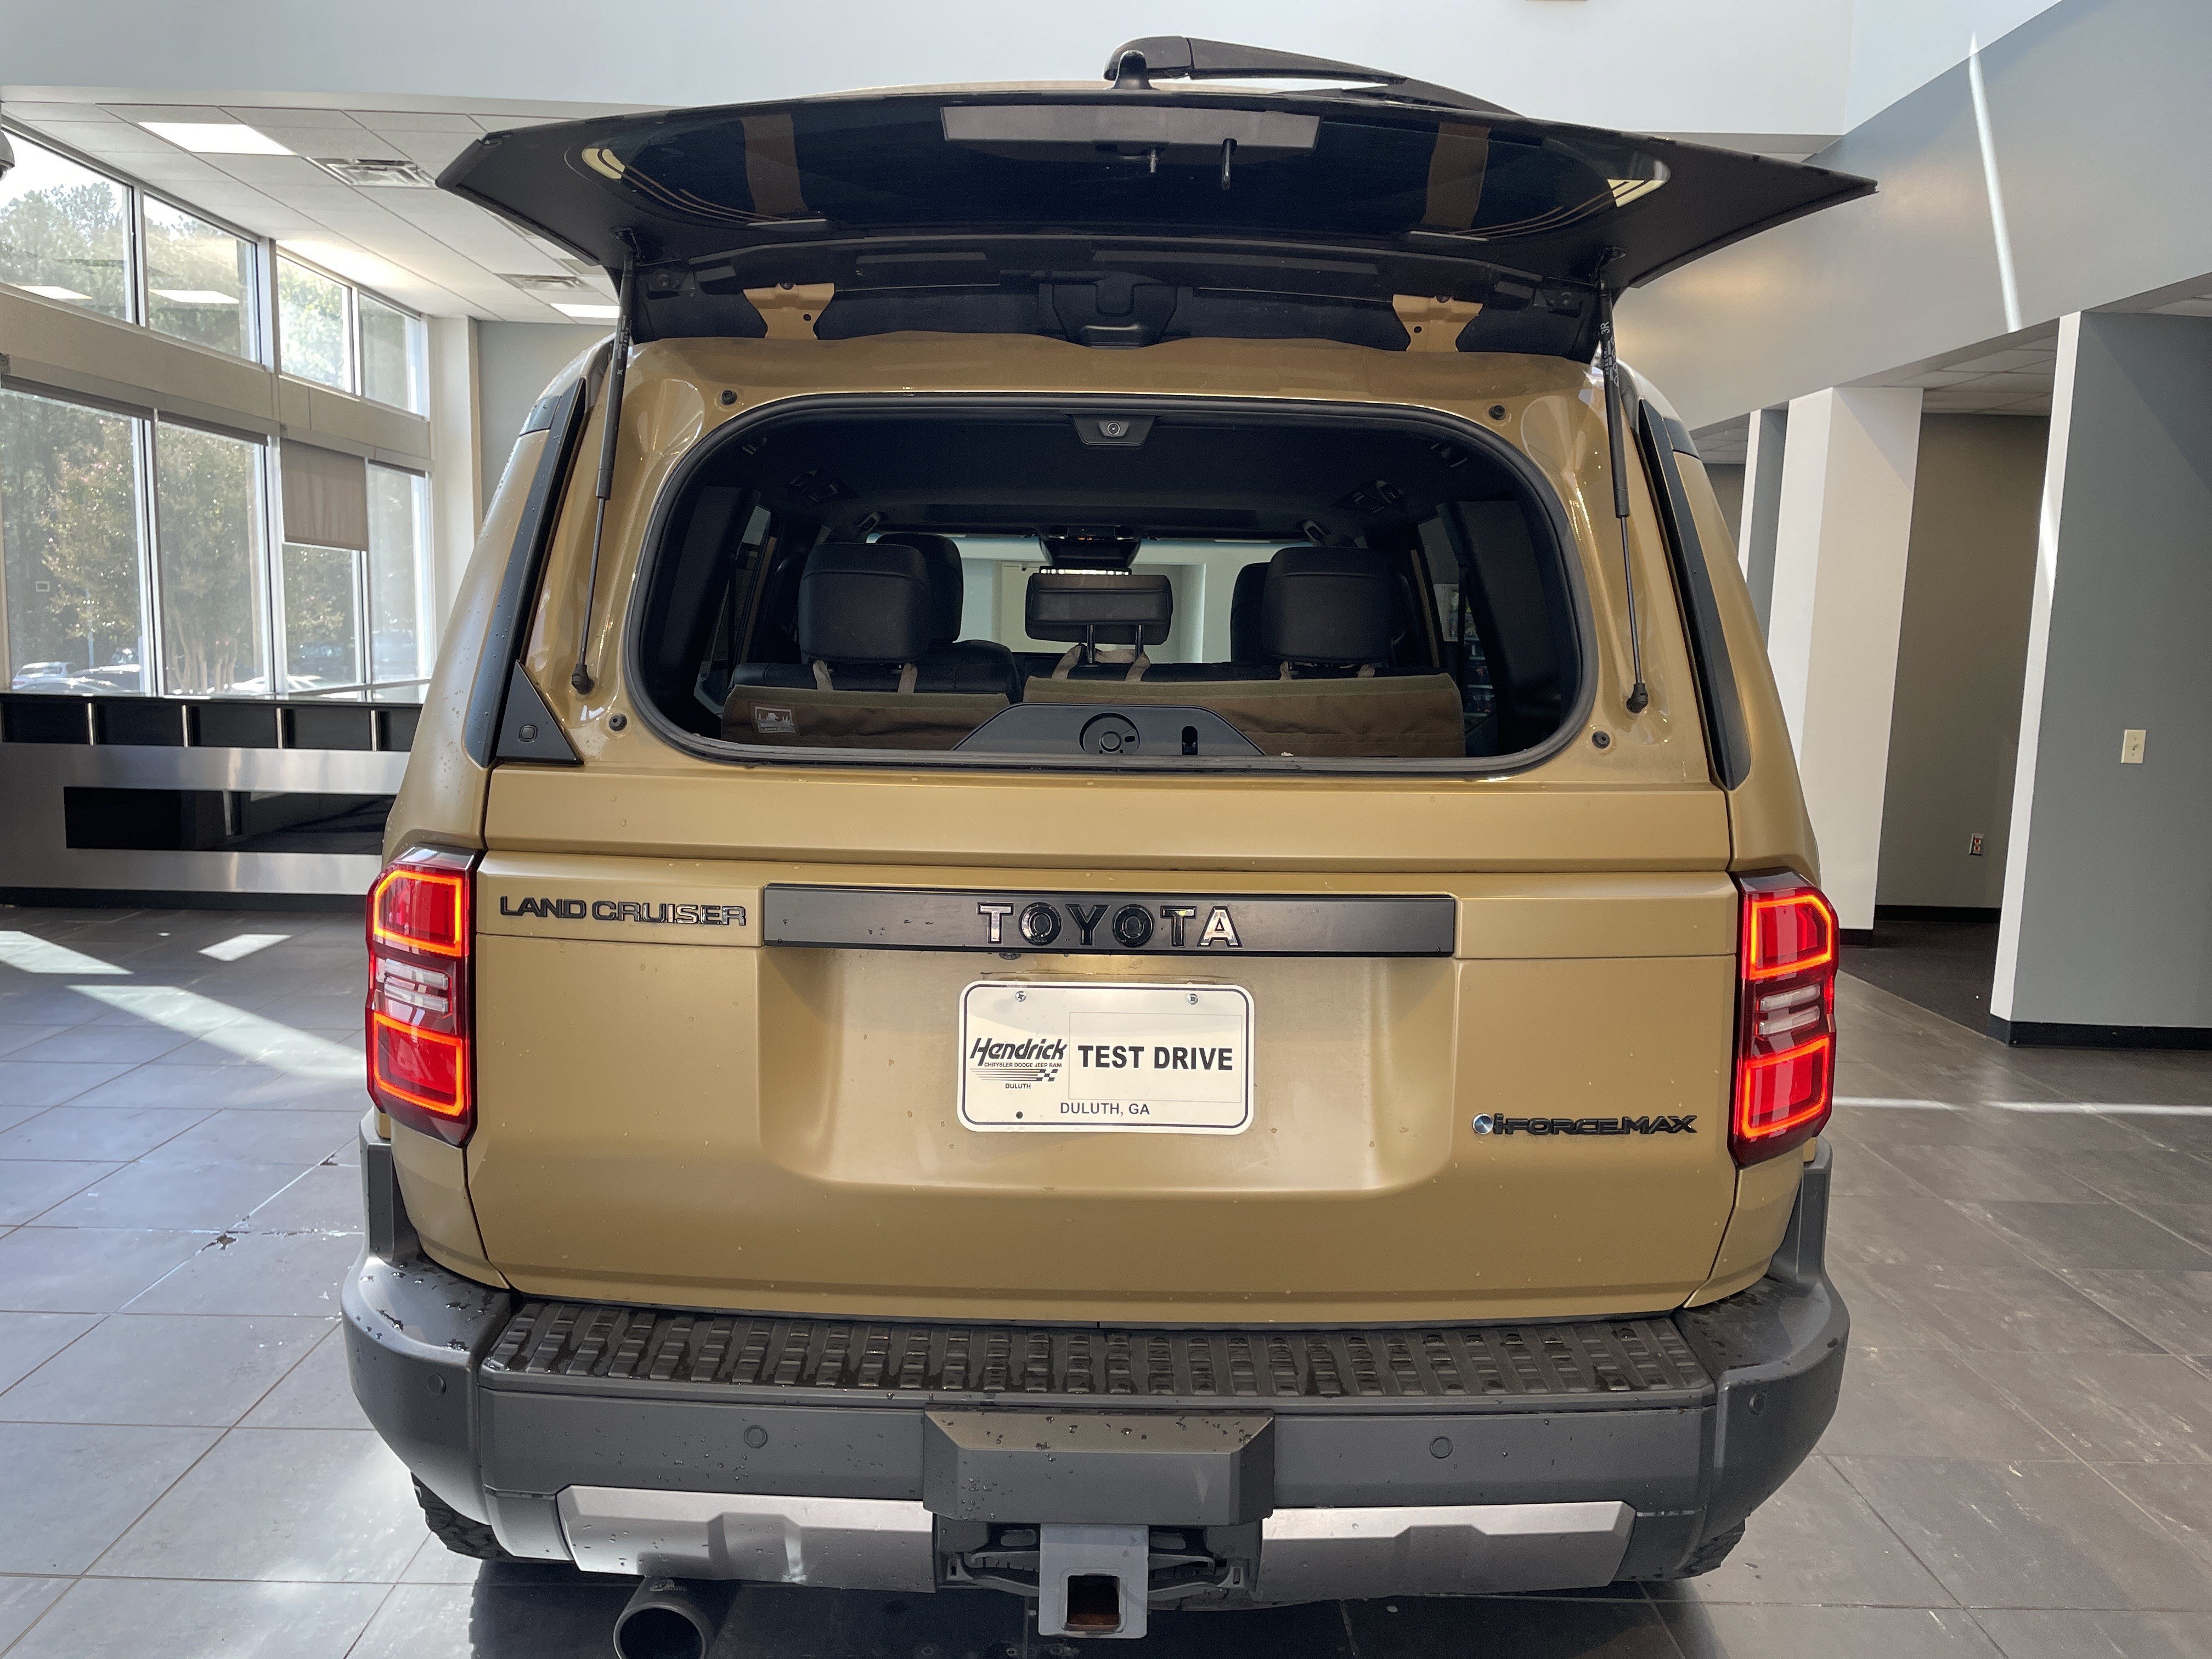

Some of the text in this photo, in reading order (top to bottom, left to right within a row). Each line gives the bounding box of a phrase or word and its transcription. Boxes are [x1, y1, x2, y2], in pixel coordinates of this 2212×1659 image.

[1600, 321, 1610, 335] 3R
[500, 895, 746, 926] LAND CRUISER
[977, 901, 1243, 949] TOYOTA
[969, 1037, 1068, 1066] Hendrick
[1077, 1045, 1233, 1070] TEST DRIVE
[1060, 1102, 1150, 1116] DULUTH, GA
